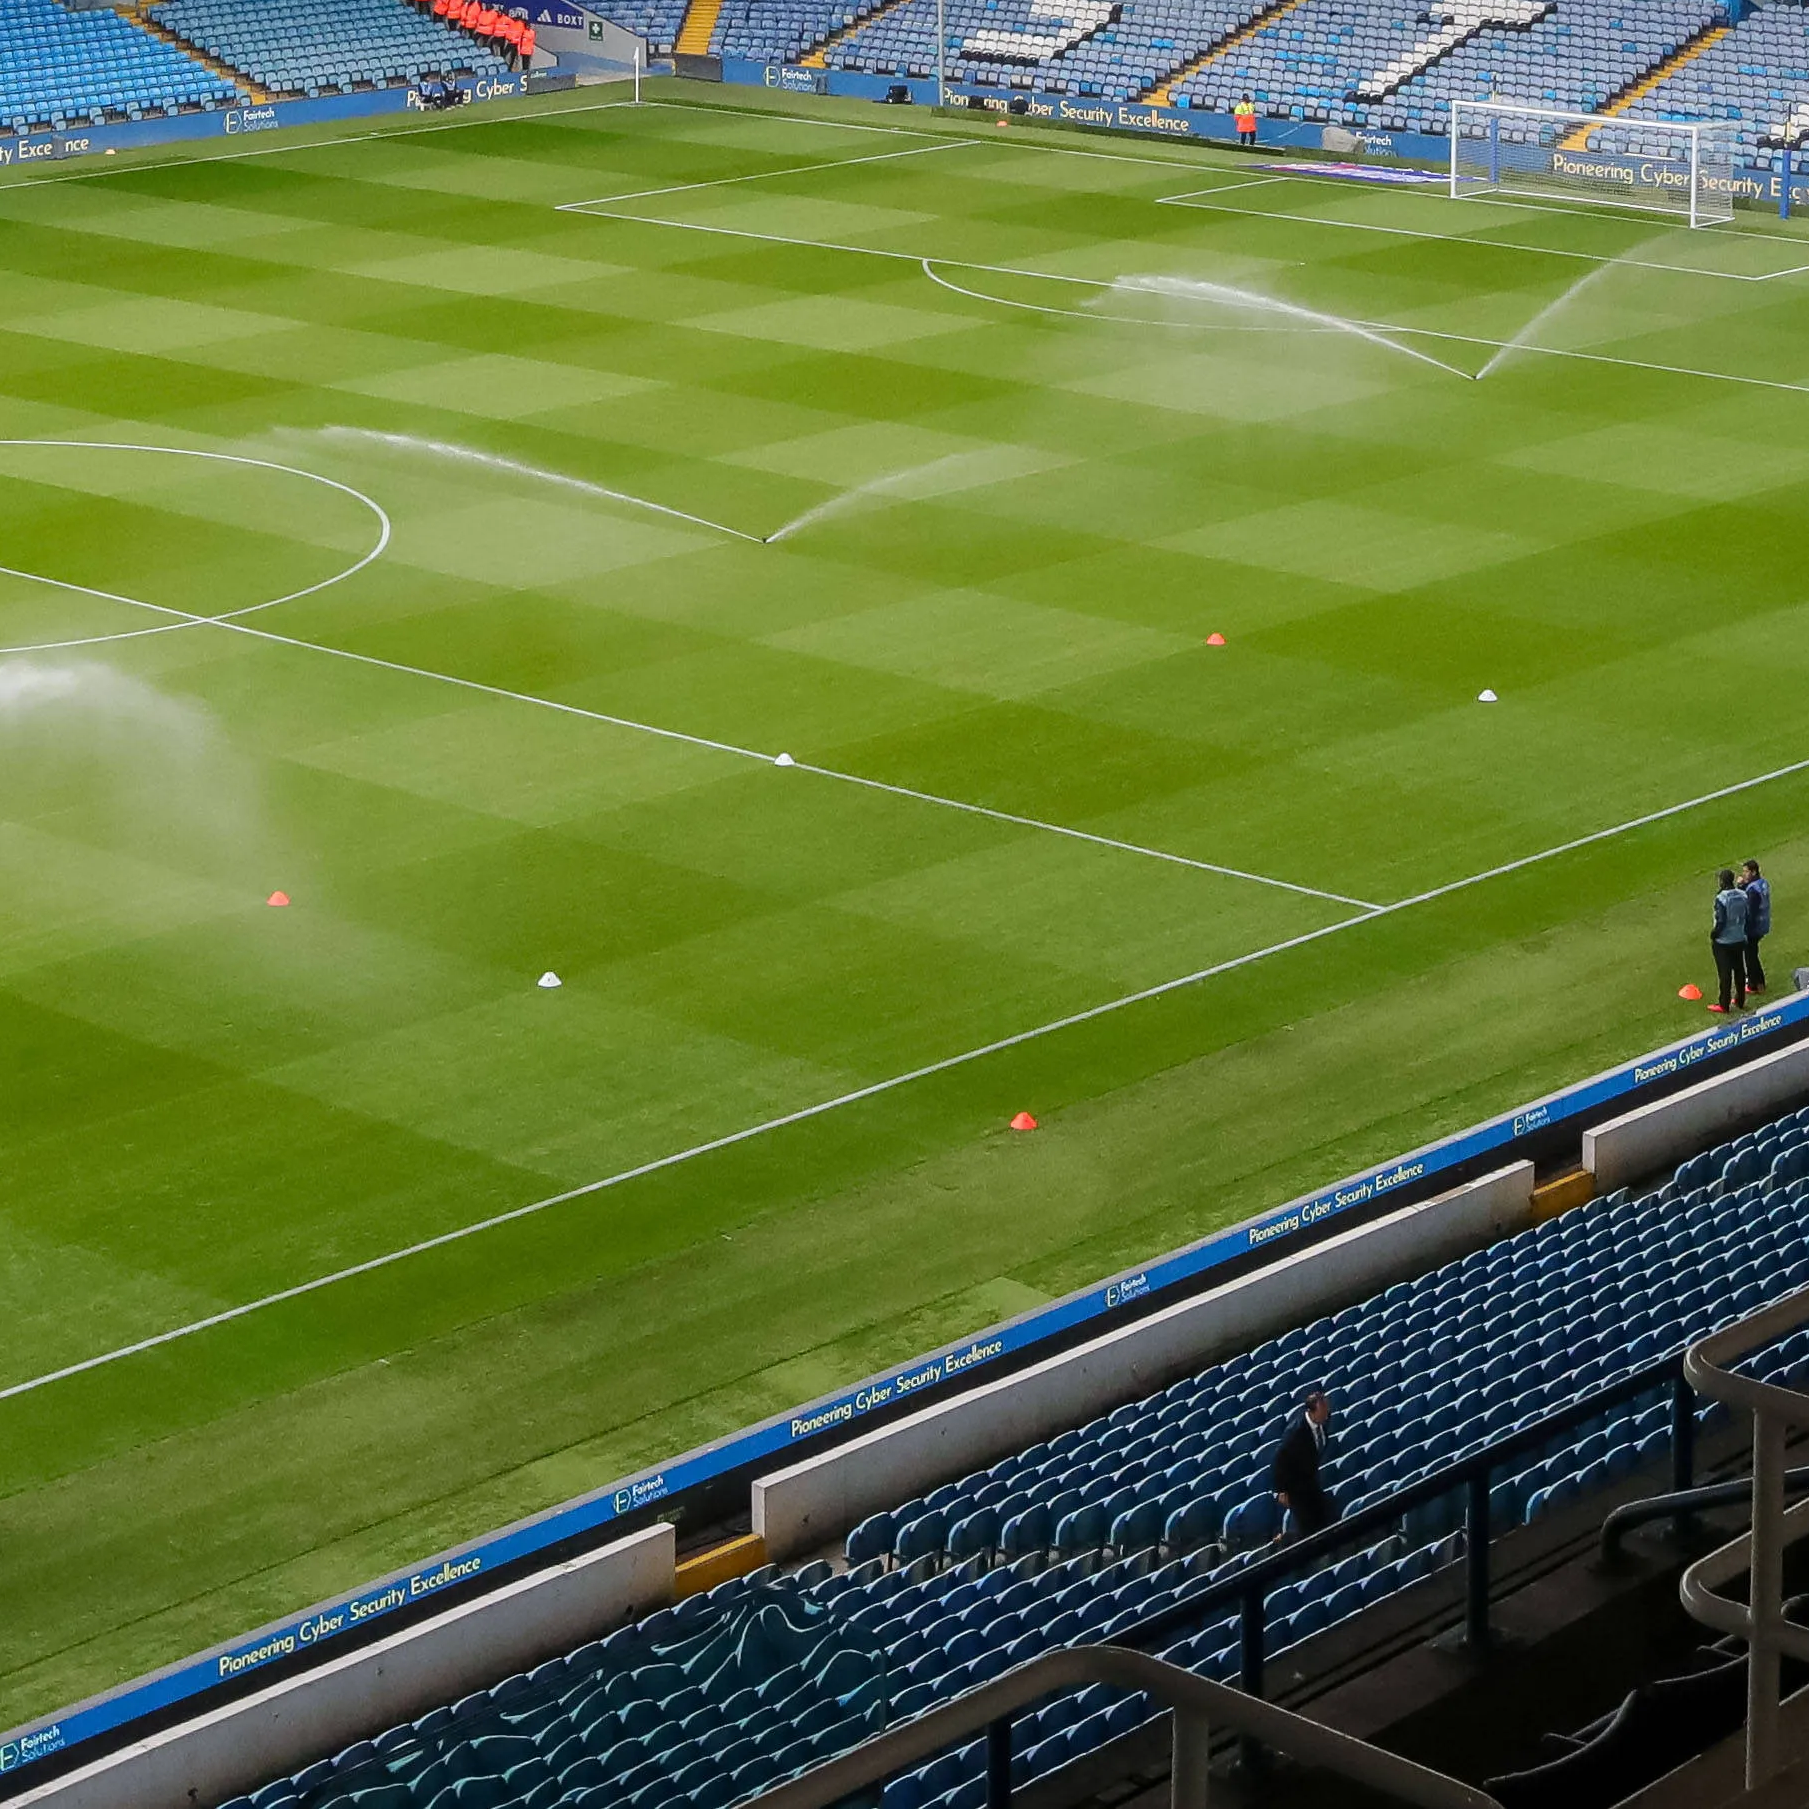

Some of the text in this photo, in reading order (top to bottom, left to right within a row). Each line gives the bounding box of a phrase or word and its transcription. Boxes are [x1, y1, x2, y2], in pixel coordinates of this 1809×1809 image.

[557, 14, 583, 28] BOXT
[782, 66, 812, 80] Fairtech
[477, 79, 514, 100] Cyber
[244, 109, 274, 120] Fairtech
[945, 89, 1188, 131] Pionring Security Excellence
[243, 117, 279, 133] Solutions
[19, 139, 88, 158] Excence
[1554, 153, 1635, 184] Pioneering
[1641, 164, 1690, 187] Cyber
[1699, 169, 1763, 199] Security
[1250, 1165, 1423, 1243] Pioneering Cyber Security Excellence
[789, 1342, 1001, 1436] Pioneering Cyber Security Excellence
[220, 1559, 480, 1679] Pioneering Cyber Security Excellence
